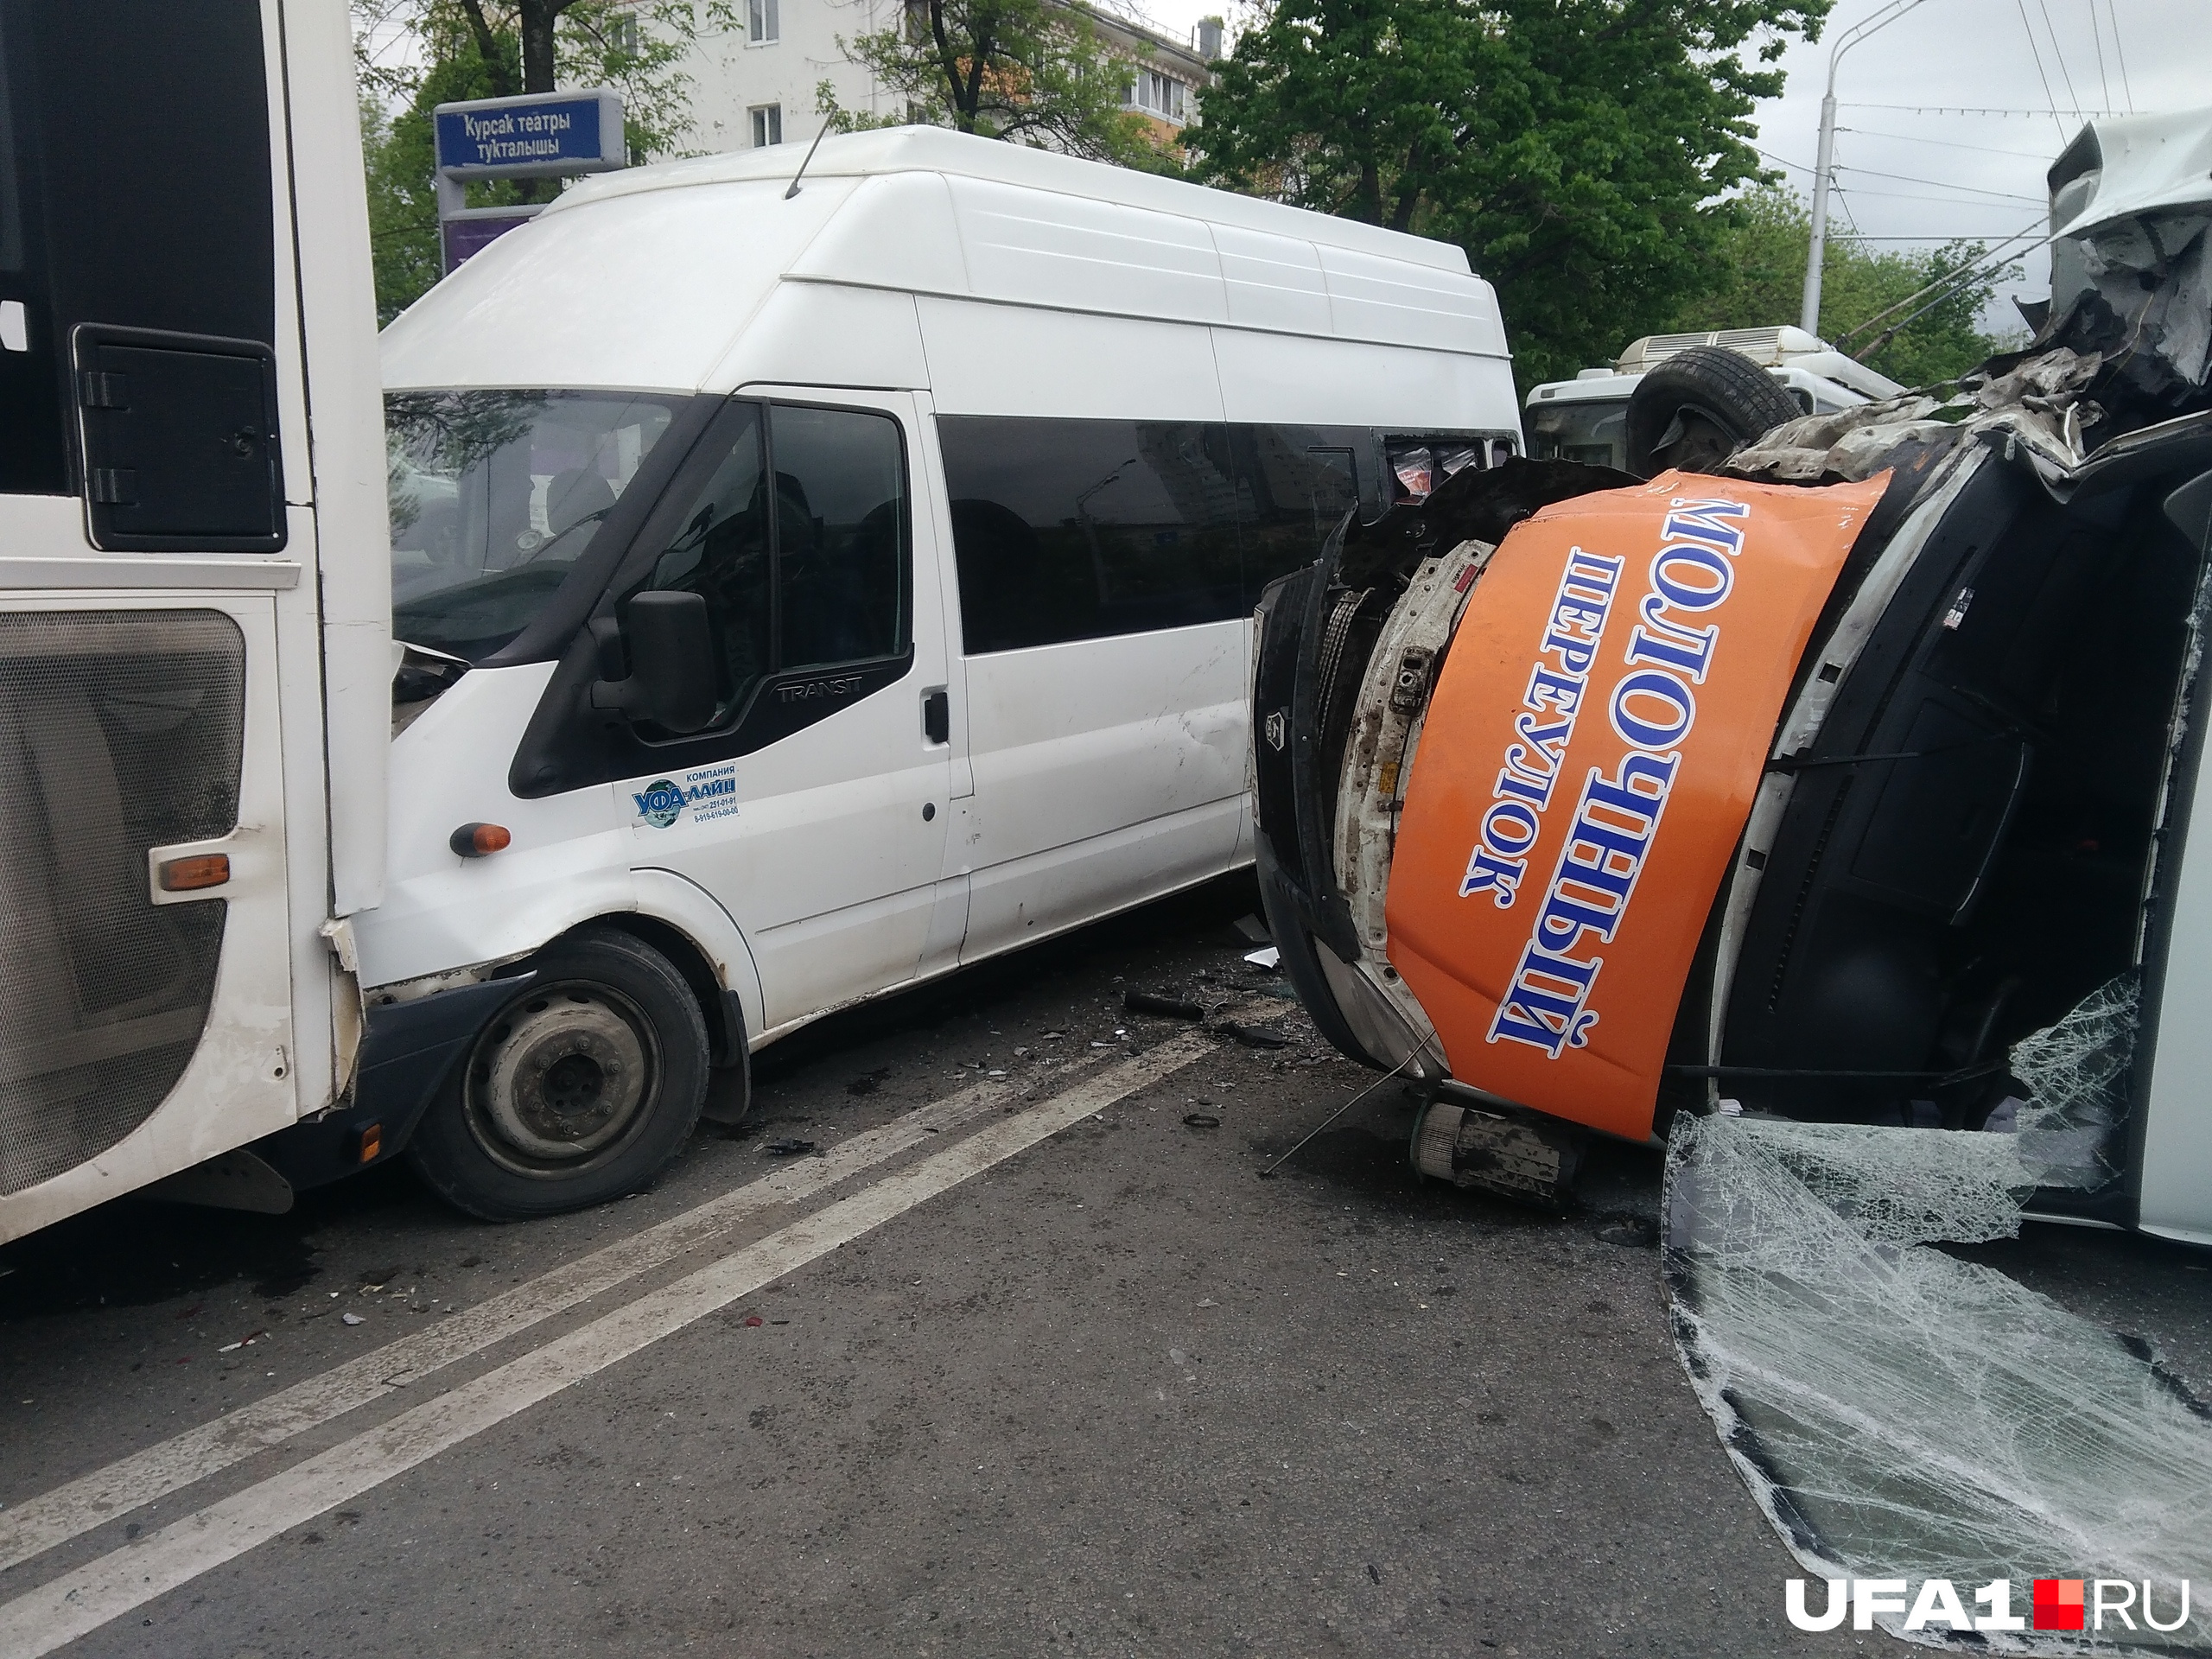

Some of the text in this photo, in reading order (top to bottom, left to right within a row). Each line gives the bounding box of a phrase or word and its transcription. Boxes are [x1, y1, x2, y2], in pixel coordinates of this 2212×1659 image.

[518, 112, 571, 136] театры
[778, 676, 863, 703] TRANSIT
[1459, 545, 1625, 909] ПЕРЕУЛОК
[686, 765, 735, 783] КОМПАНИЯ
[1485, 498, 1751, 1060] МОЛОЧНЫЙ
[694, 806, 739, 823] 8-919-619-00-00
[709, 796, 737, 810] 251-01-91
